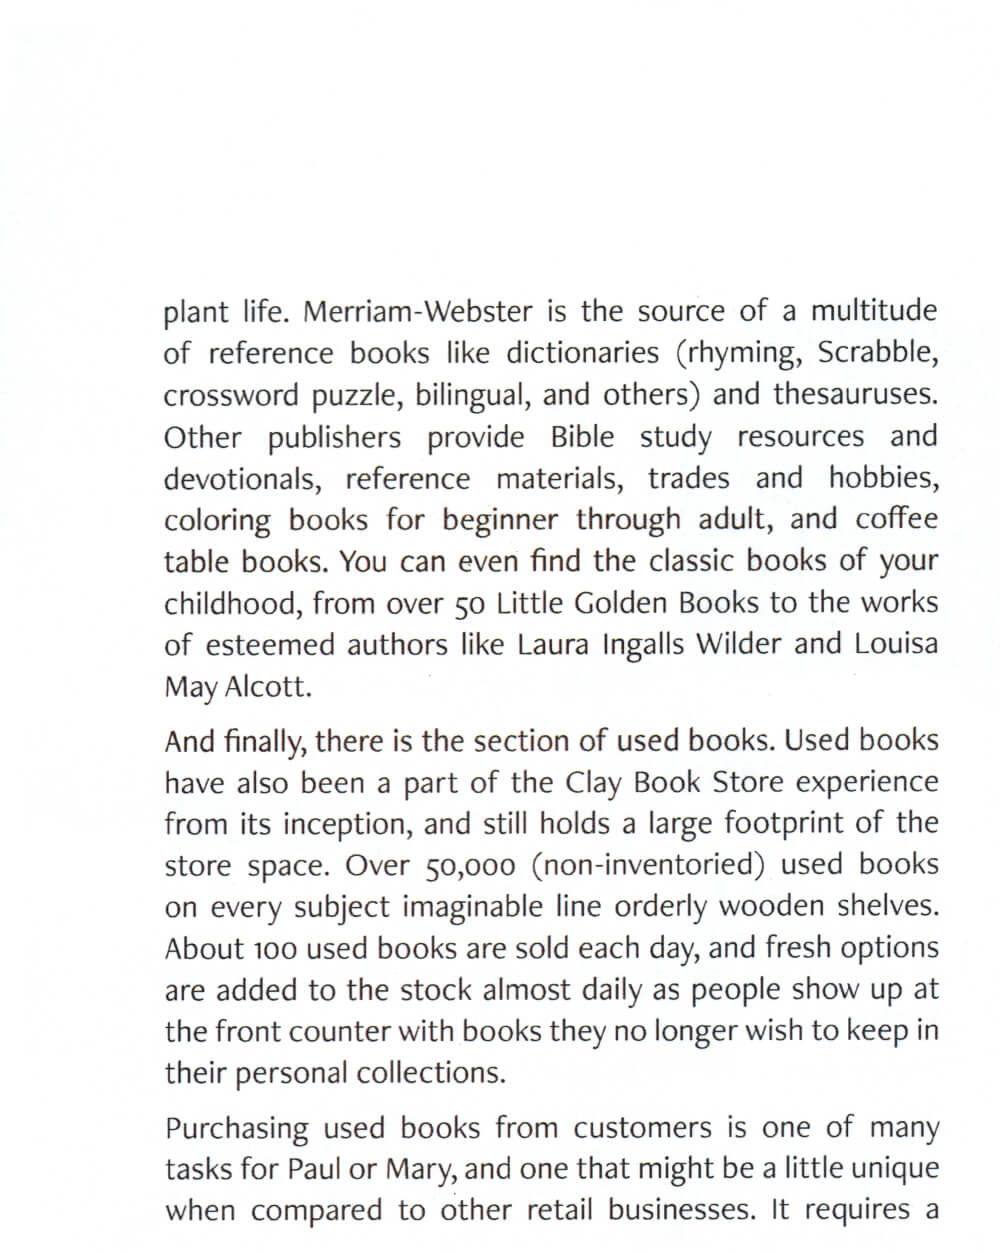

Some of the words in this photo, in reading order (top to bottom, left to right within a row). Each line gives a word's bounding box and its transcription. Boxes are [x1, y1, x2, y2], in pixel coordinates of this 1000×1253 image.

[164, 298, 229, 331] plant
[244, 298, 289, 323] life.
[304, 298, 534, 323] Merriam-Webster
[548, 298, 567, 323] is
[581, 297, 624, 323] the
[638, 304, 725, 322] source
[739, 296, 769, 322] of
[783, 304, 796, 322] a
[812, 296, 937, 322] multitude
[164, 590, 303, 620] childhood,
[312, 590, 375, 615] from
[386, 597, 444, 615] over
[455, 596, 485, 621] 50
[498, 590, 563, 615] Little
[574, 589, 667, 614] Golden
[680, 589, 759, 614] Books
[770, 591, 798, 614] to
[808, 588, 850, 614] the
[861, 588, 939, 613] works
[165, 855, 232, 877] store
[248, 859, 330, 884] space.
[345, 854, 411, 877] Over
[426, 858, 516, 883] 50,000
[532, 850, 765, 882] (non-inventoried)
[781, 850, 842, 875] used
[860, 850, 939, 875] books
